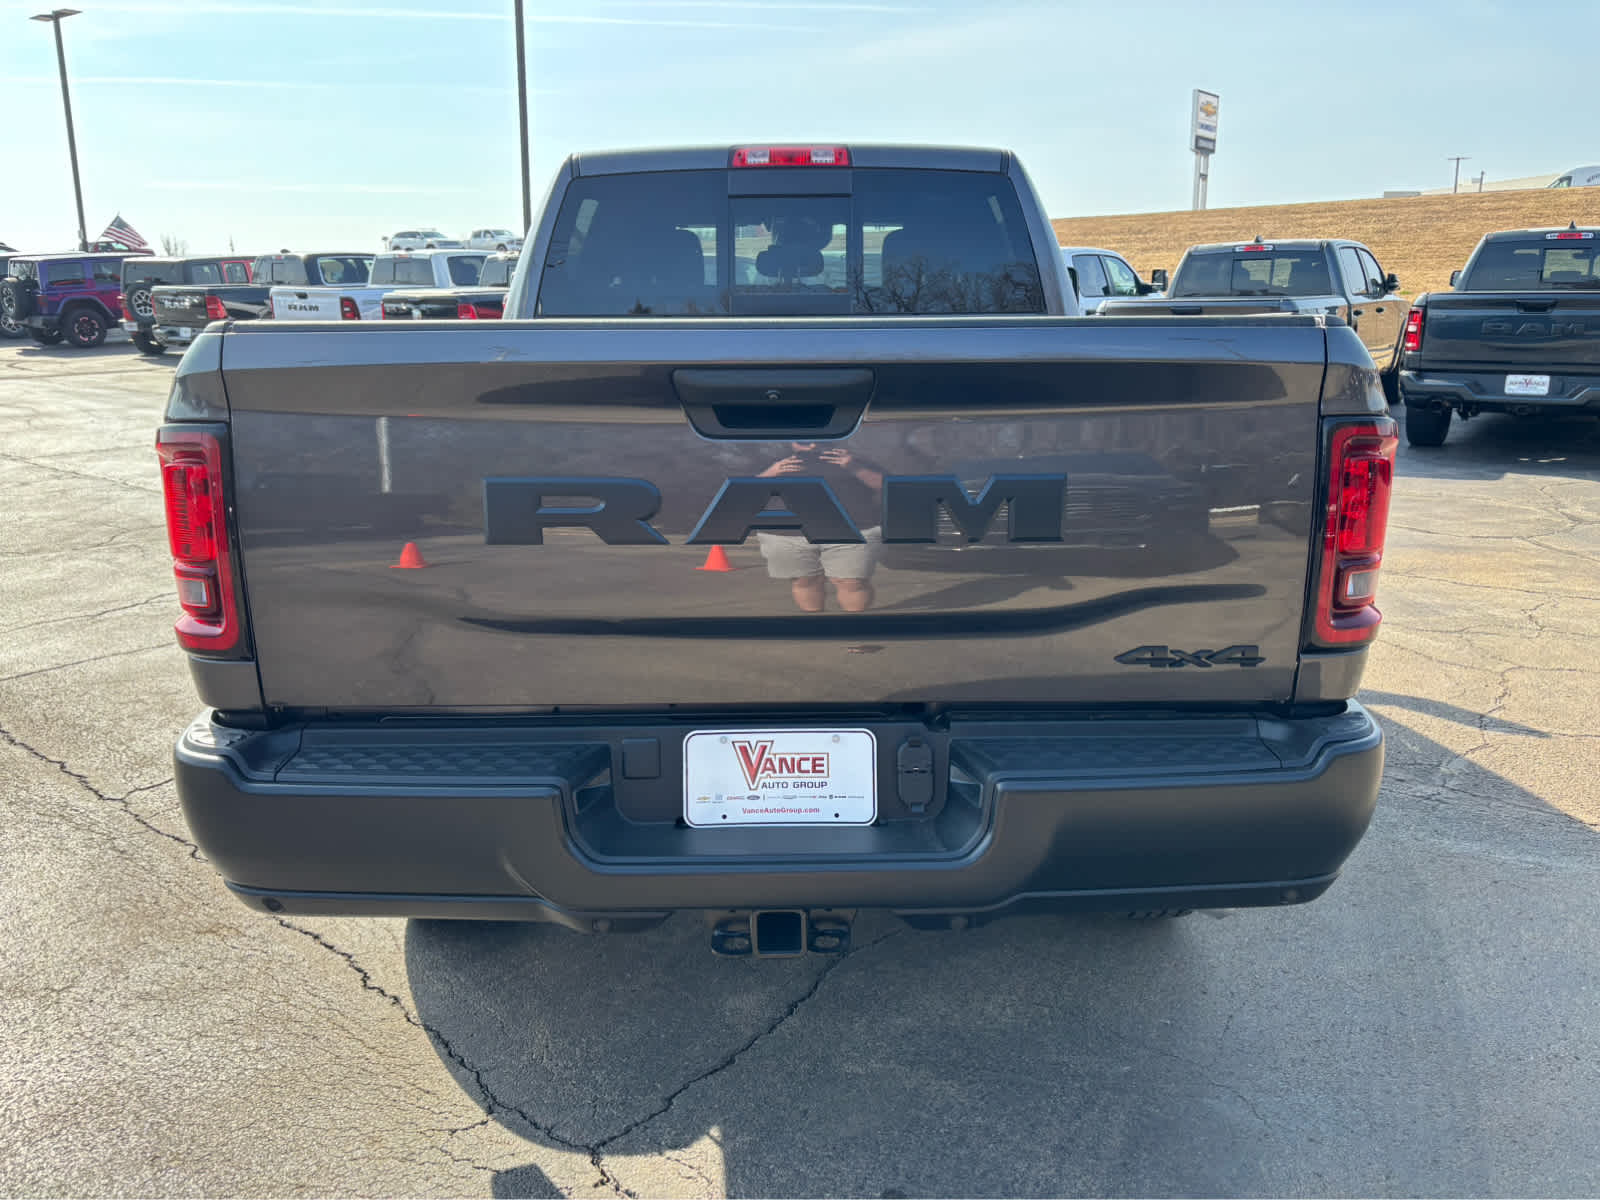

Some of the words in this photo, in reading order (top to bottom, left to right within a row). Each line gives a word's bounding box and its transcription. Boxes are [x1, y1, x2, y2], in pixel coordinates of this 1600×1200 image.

[287, 303, 320, 312] RAM
[1482, 319, 1584, 337] RAM
[482, 473, 1068, 545] RAM
[1113, 645, 1267, 668] 4x4
[733, 742, 827, 789] VANCE
[760, 781, 789, 790] AUTO
[792, 780, 829, 789] GROUP
[742, 806, 821, 815] VanceAutoGroup.com
